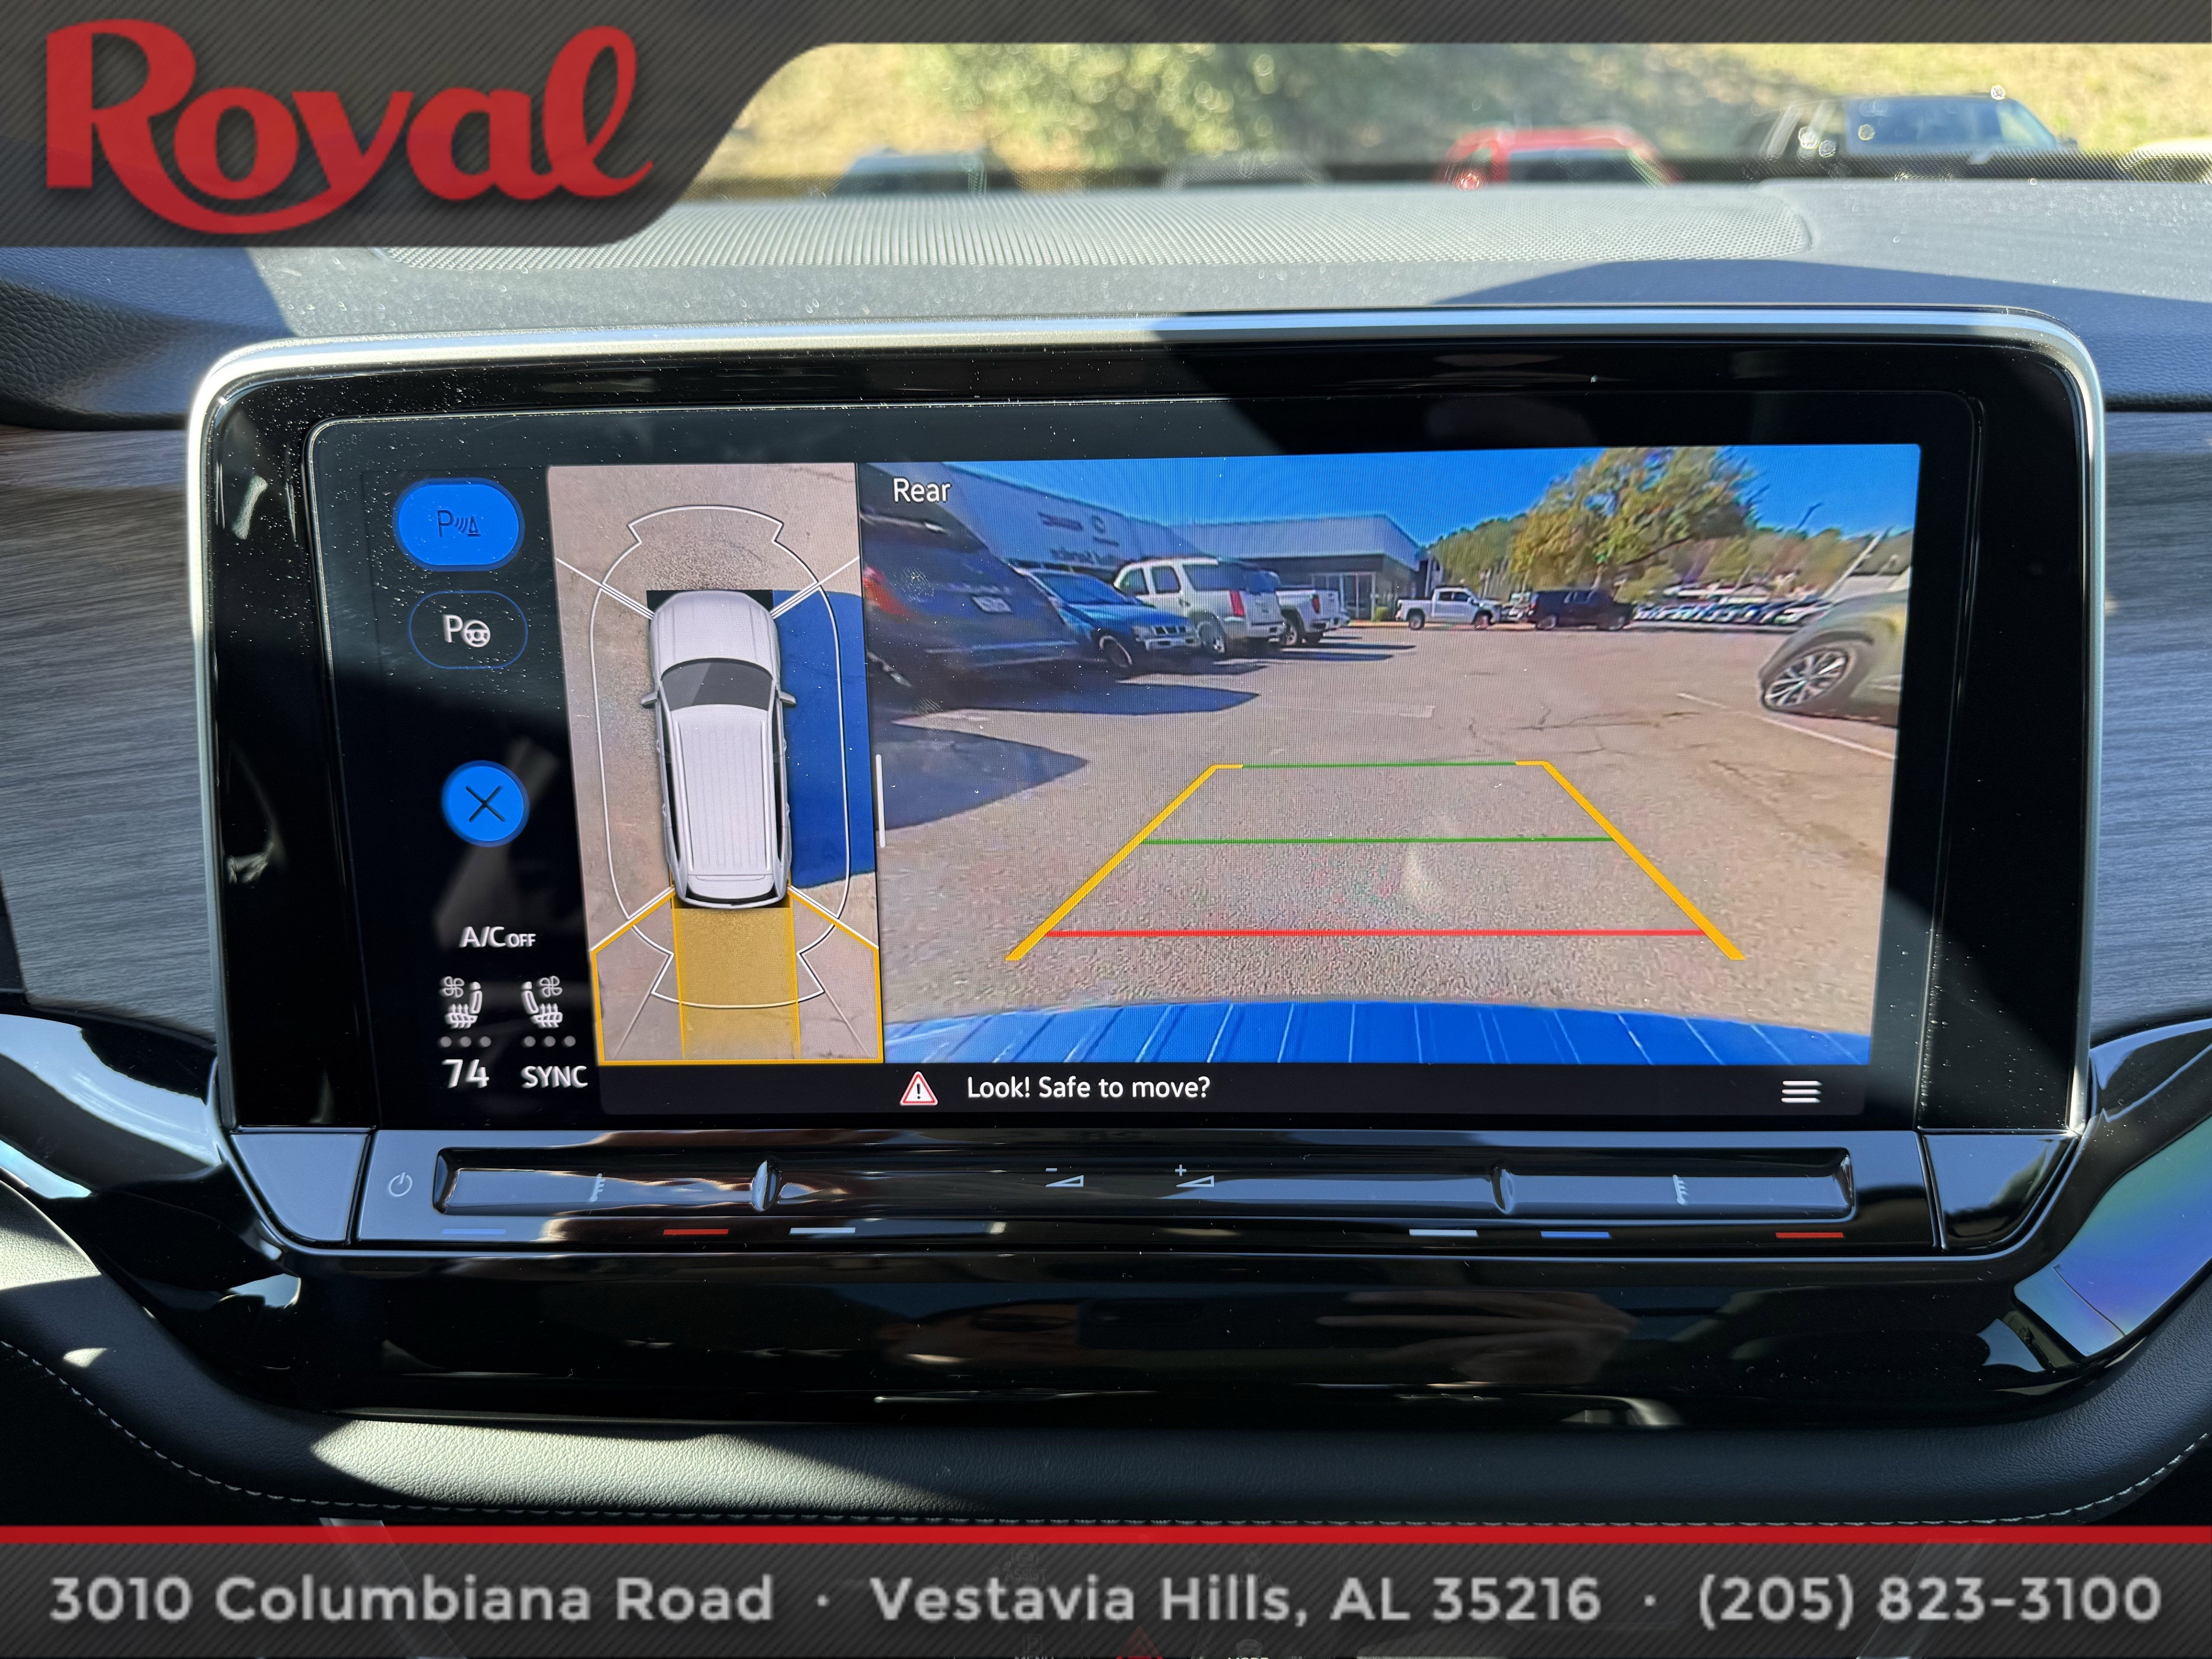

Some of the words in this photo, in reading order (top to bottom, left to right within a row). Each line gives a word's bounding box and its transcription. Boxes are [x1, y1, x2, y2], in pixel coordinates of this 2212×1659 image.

[893, 477, 952, 503] Rear
[441, 1059, 489, 1088] 74
[521, 1065, 588, 1088] SYNC
[967, 1076, 1030, 1099] Look!
[1039, 1076, 1091, 1099] Safe
[1098, 1078, 1124, 1099] to
[1132, 1076, 1210, 1099] move?
